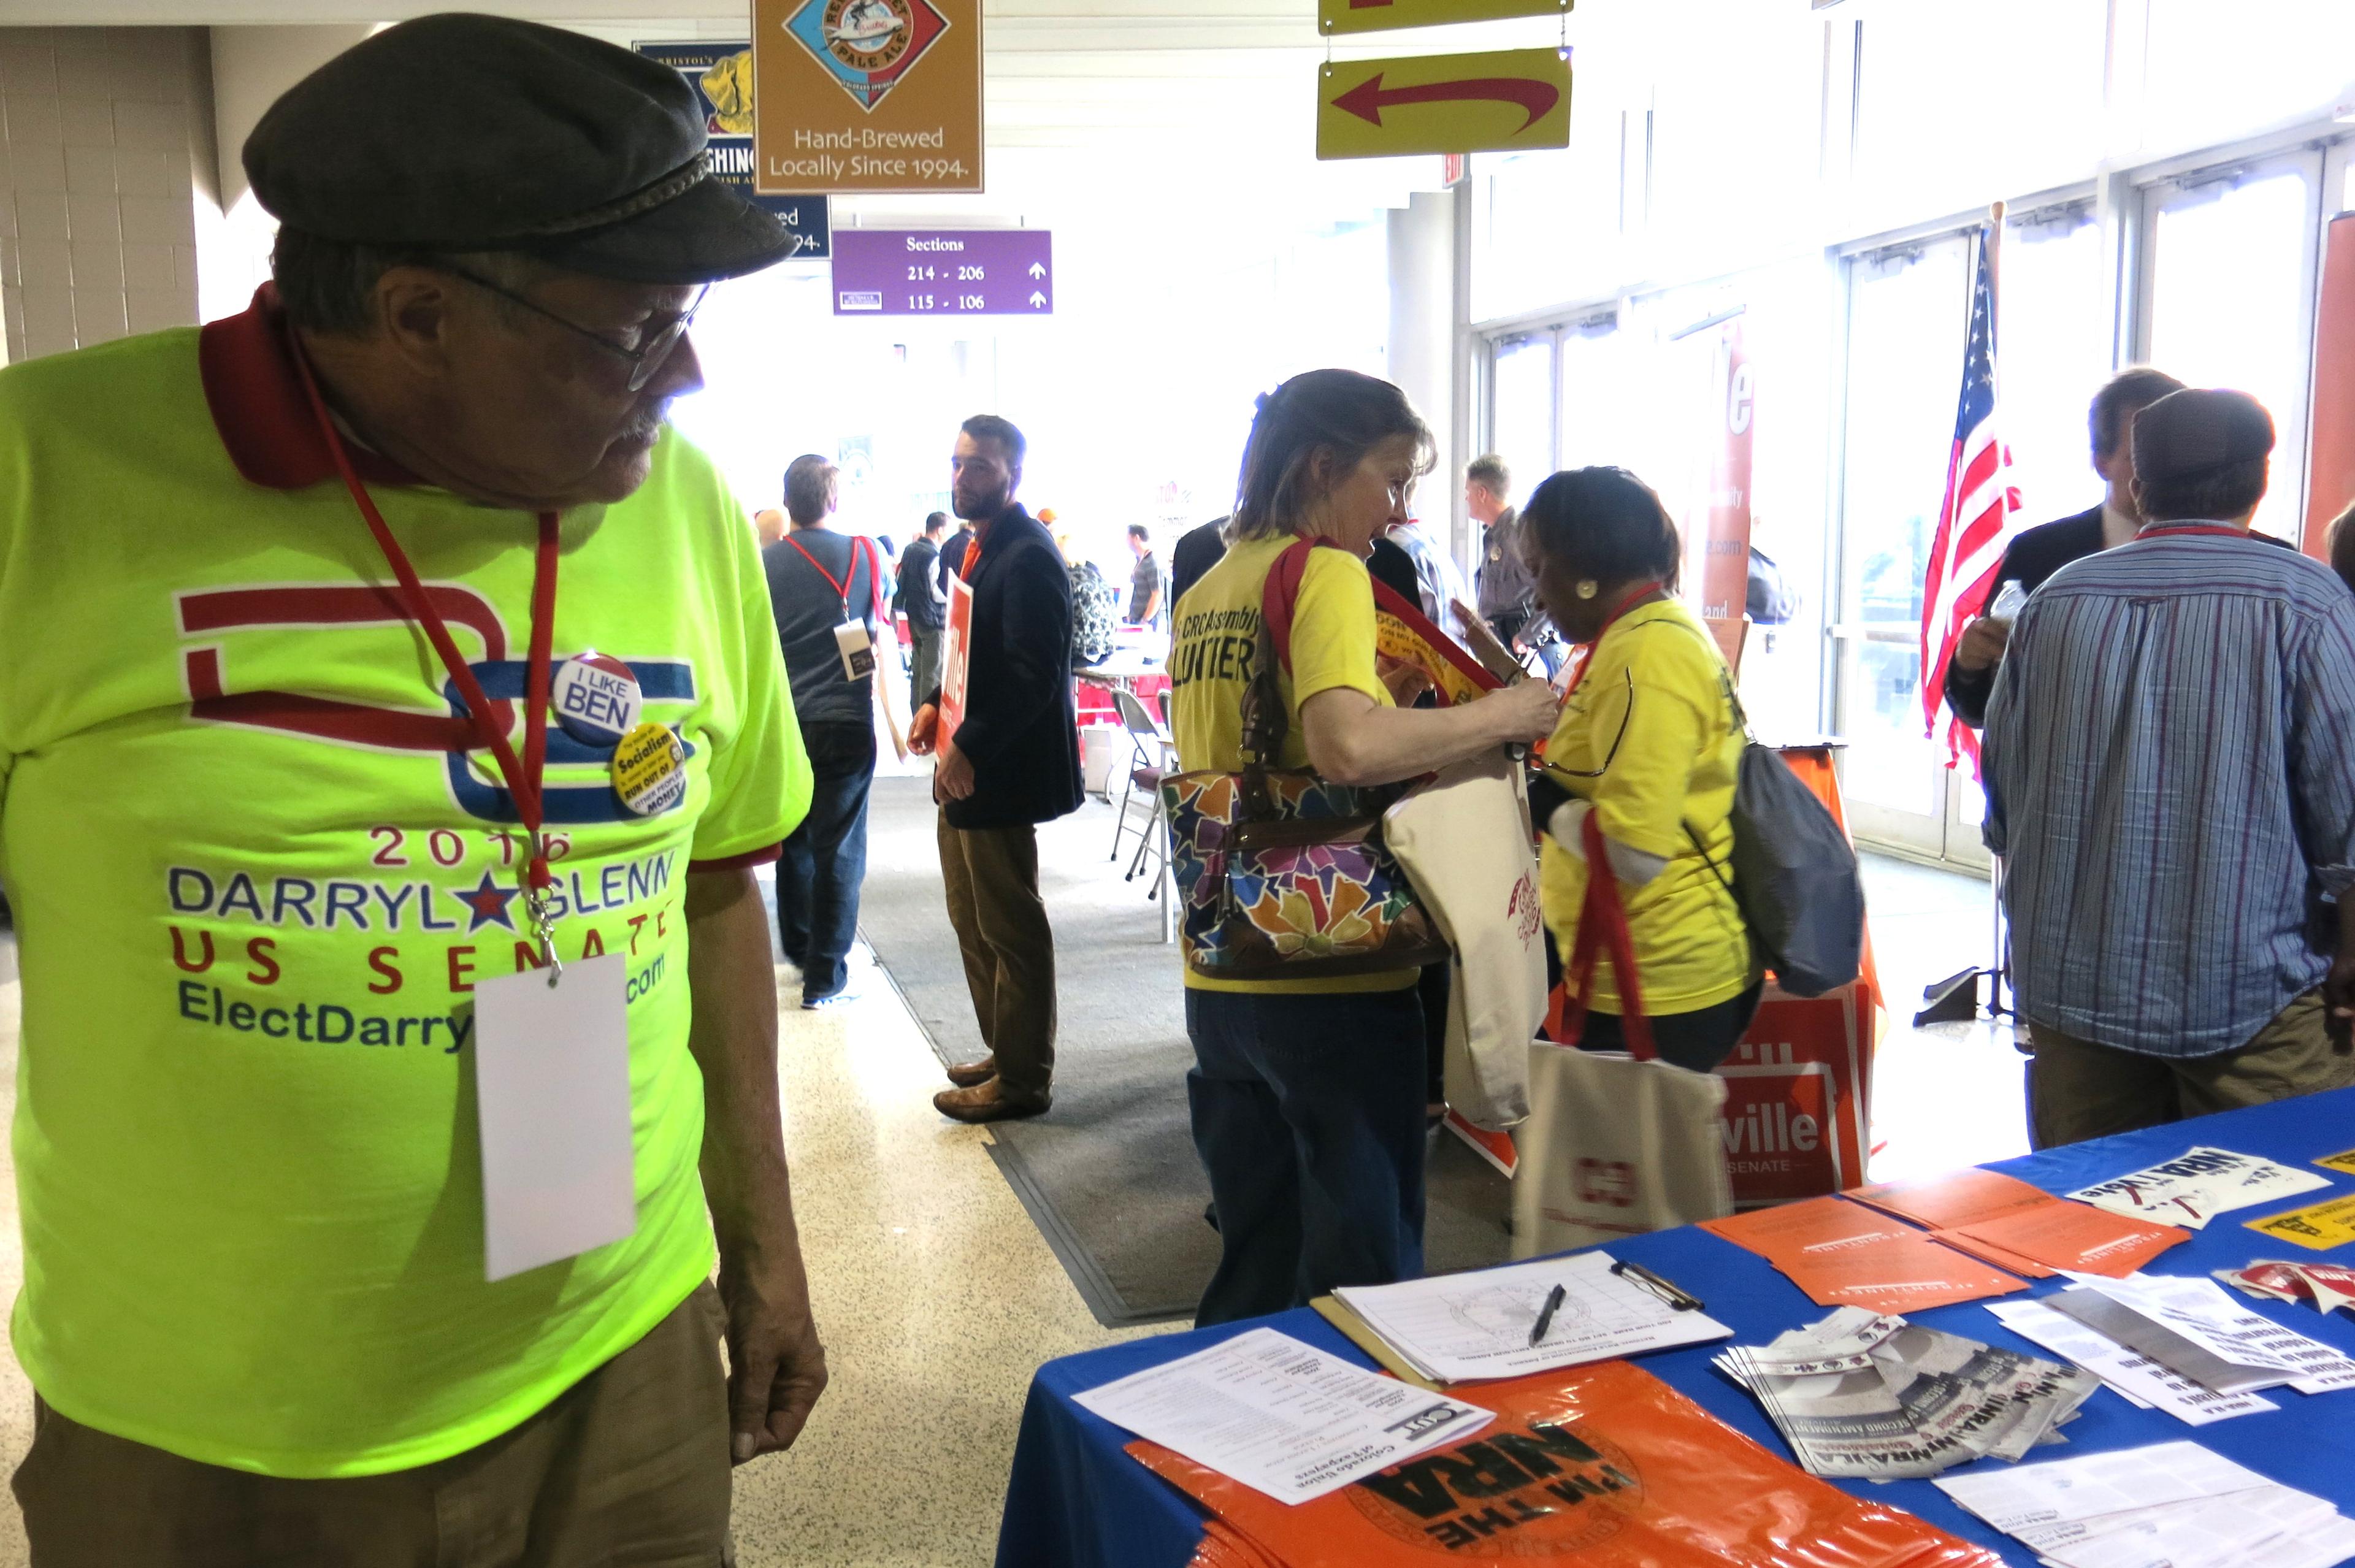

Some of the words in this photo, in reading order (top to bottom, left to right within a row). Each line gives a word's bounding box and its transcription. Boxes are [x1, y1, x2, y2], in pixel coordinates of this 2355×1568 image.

[837, 45, 878, 67] PALE
[884, 33, 908, 61] ALE
[794, 127, 944, 149] Hand-Brewed
[770, 154, 844, 181] Locally
[851, 155, 906, 176] Since
[911, 159, 969, 179] 1994.
[906, 236, 965, 251] Sections
[907, 266, 935, 281] 214
[957, 266, 986, 281] 206
[908, 294, 935, 310] 115
[958, 294, 986, 310] 106
[576, 667, 584, 682] I
[588, 670, 629, 698] LIKE
[564, 681, 630, 730] BEN
[618, 732, 671, 774] Socialism
[624, 782, 644, 800] RUN
[643, 770, 659, 788] OUT
[634, 790, 657, 809] OTHER
[647, 782, 680, 814] MONEY
[169, 867, 456, 930] DARRYL
[169, 926, 281, 985] US
[1728, 1159, 1791, 1174] SENATE
[2149, 1151, 2247, 1177] NRA
[1866, 1420, 1911, 1433] SECOND
[1337, 1444, 1396, 1472] Colorado
[1353, 1423, 1604, 1520] NRA
[1294, 1471, 1338, 1490] Union
[1545, 1464, 1637, 1506] I'M
[1423, 1497, 1558, 1550] THE
